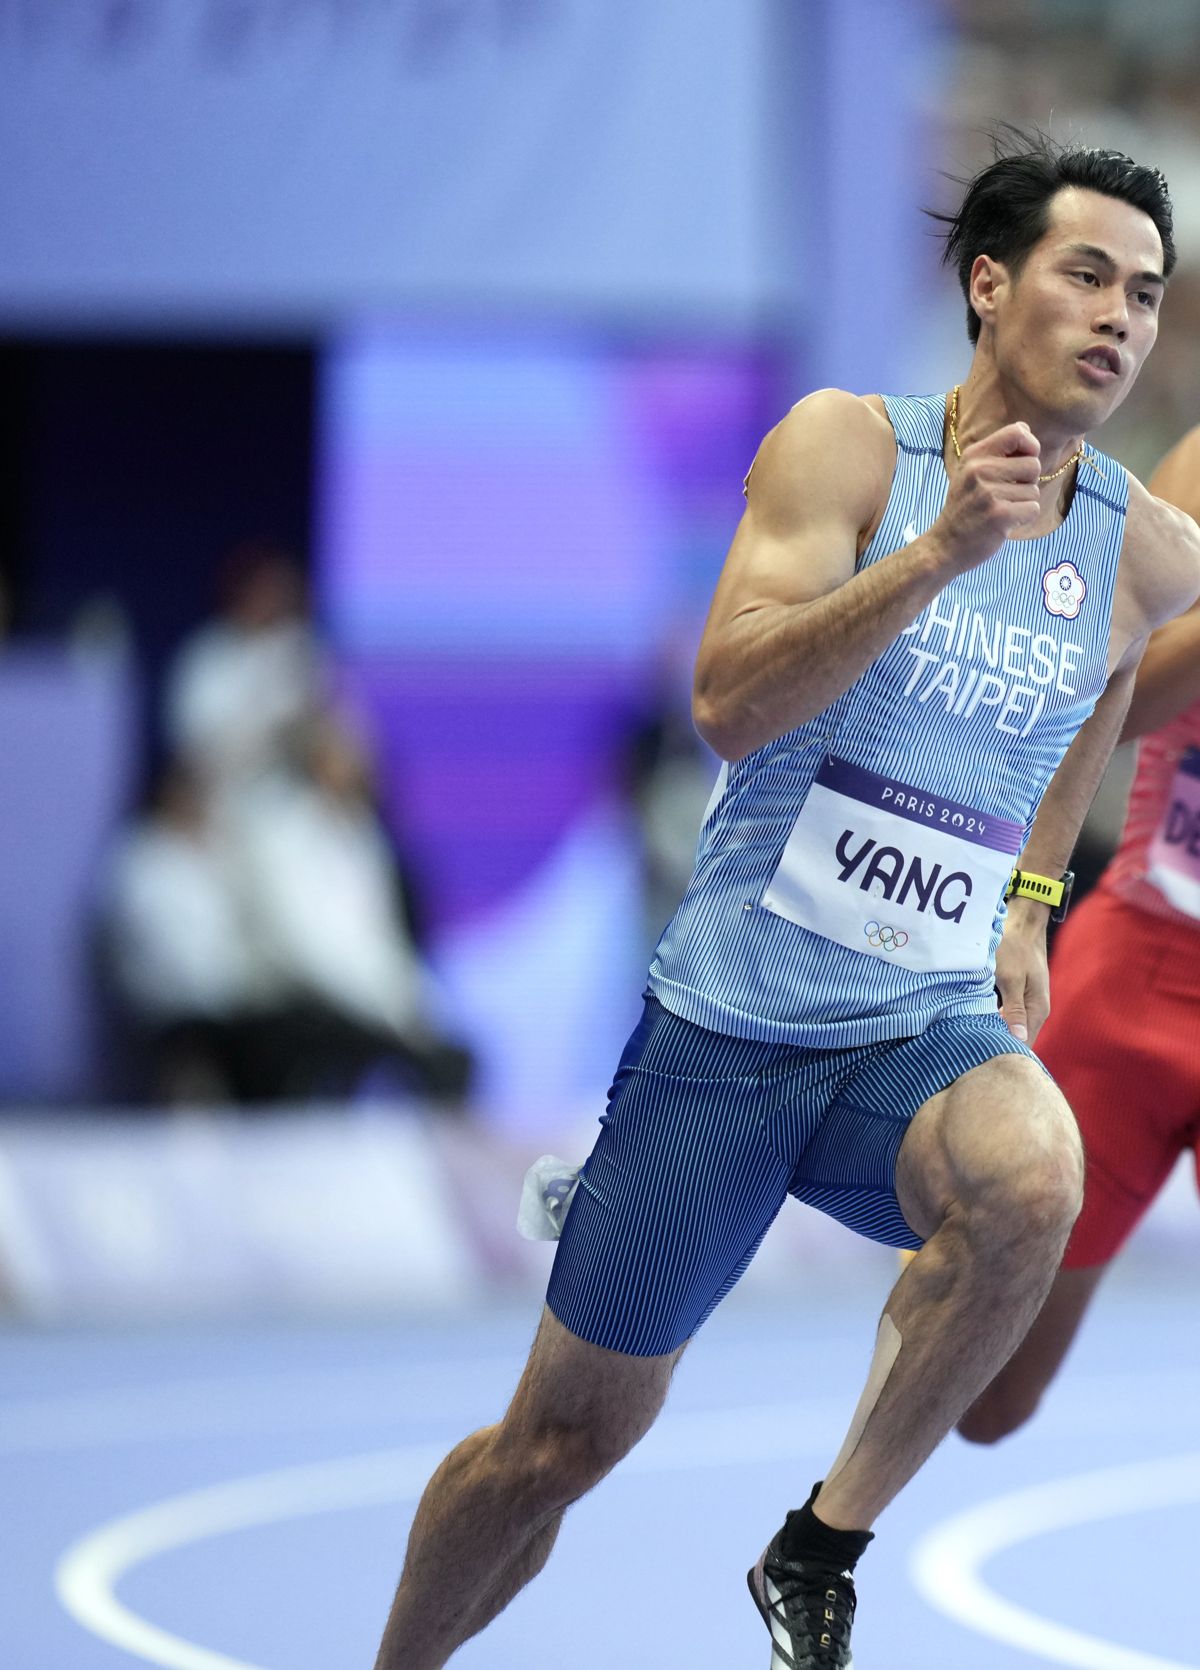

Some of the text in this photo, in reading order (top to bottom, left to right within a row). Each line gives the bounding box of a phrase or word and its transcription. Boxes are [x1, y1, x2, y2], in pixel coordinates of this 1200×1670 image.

[902, 598, 1084, 696] HINESE
[905, 647, 1045, 738] TAIPEI
[881, 786, 936, 818] PARIS
[835, 829, 973, 924] YANG
